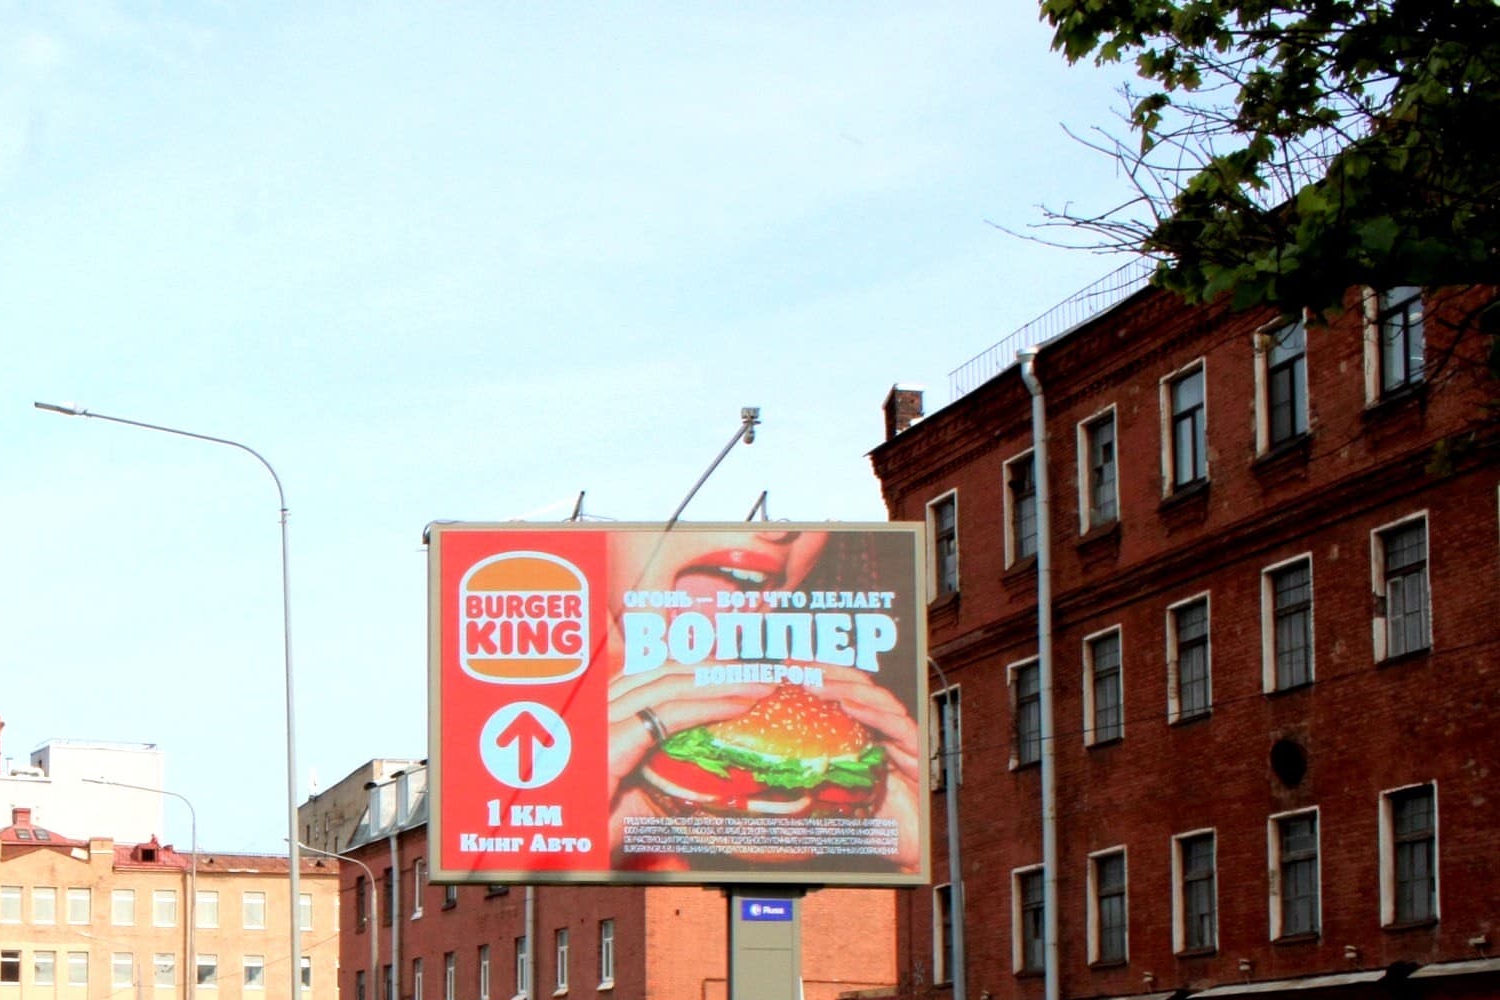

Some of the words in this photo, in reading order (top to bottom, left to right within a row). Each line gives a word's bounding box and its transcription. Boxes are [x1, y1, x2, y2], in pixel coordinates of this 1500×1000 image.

[466, 595, 582, 619] BURGER
[623, 591, 693, 608] ОГОНЬ
[716, 592, 760, 608] ВОТ
[763, 592, 807, 608] ЧТО
[810, 592, 895, 609] ДЕЛАЕТ
[466, 620, 583, 655] KING
[623, 611, 898, 676] ВОППЕР
[694, 664, 824, 688] ВОППЕРОМ
[487, 799, 501, 826] 1
